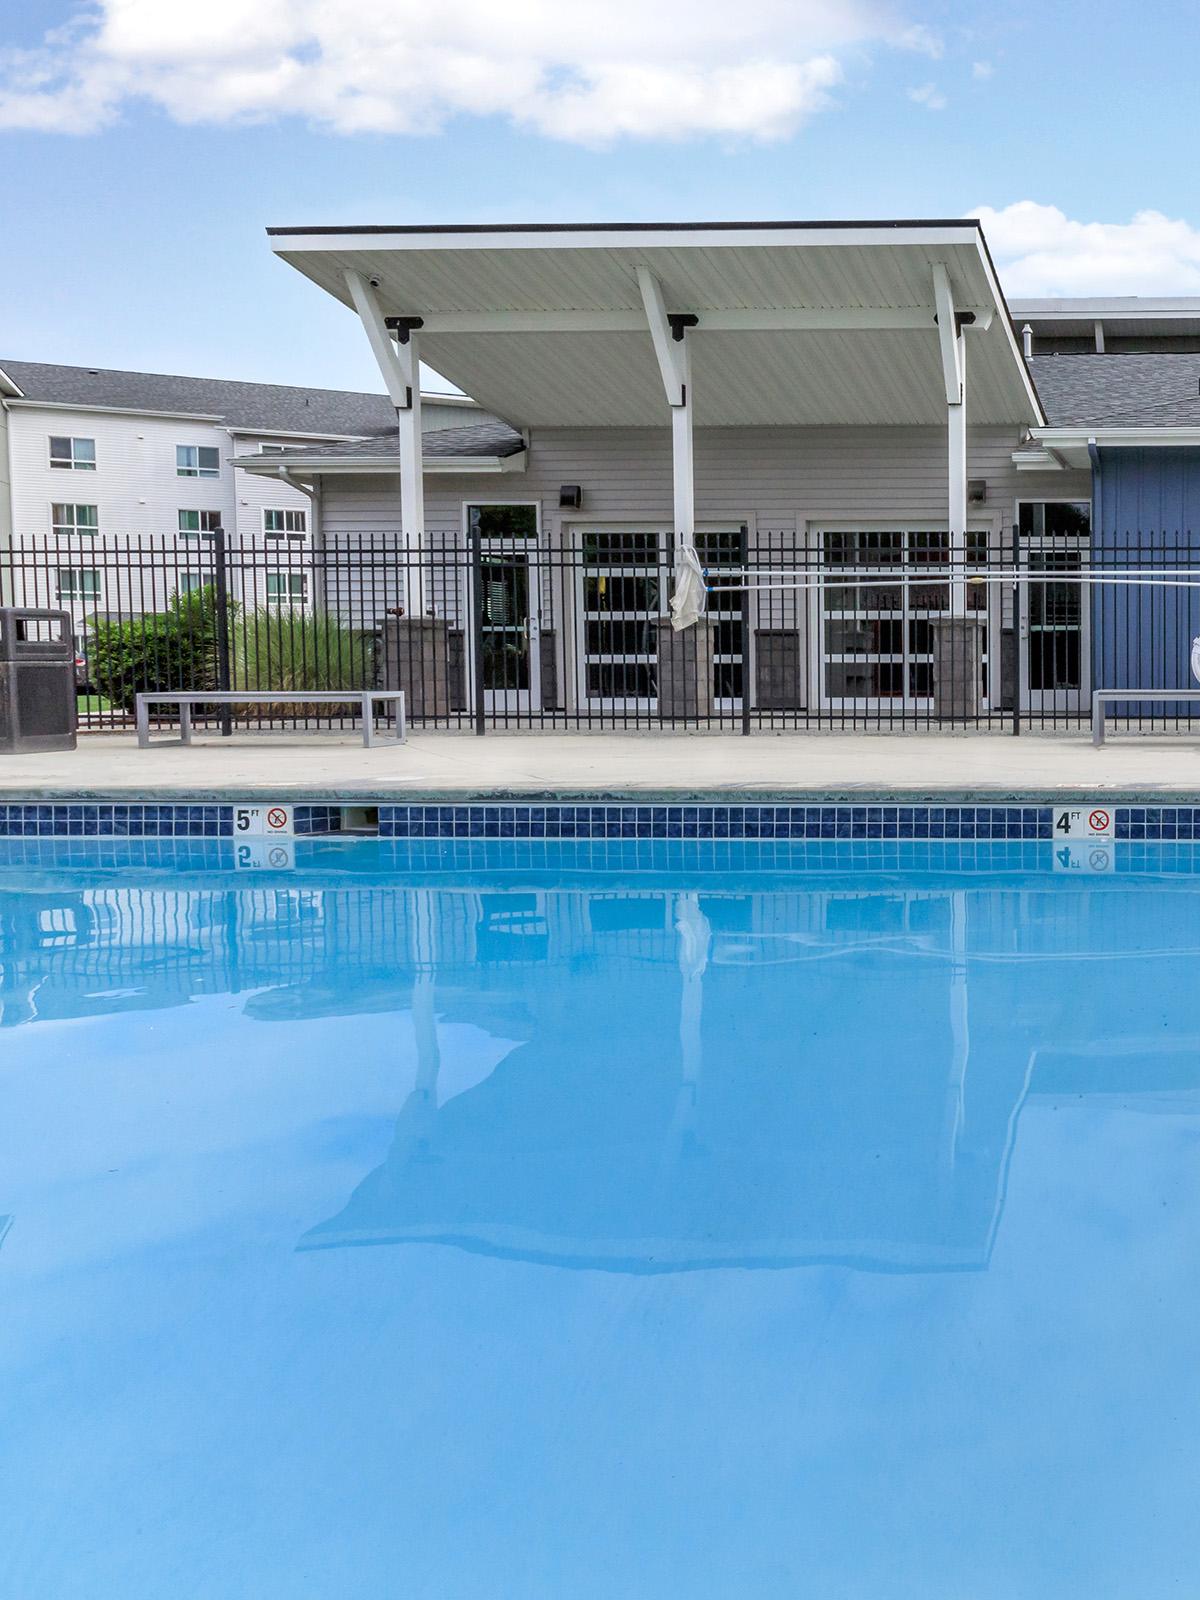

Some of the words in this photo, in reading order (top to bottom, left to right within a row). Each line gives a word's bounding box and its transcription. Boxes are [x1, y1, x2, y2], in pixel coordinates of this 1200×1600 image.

[237, 809, 250, 831] 5
[251, 809, 259, 817] FT
[1056, 812, 1071, 834] 4
[1071, 811, 1081, 820] FT
